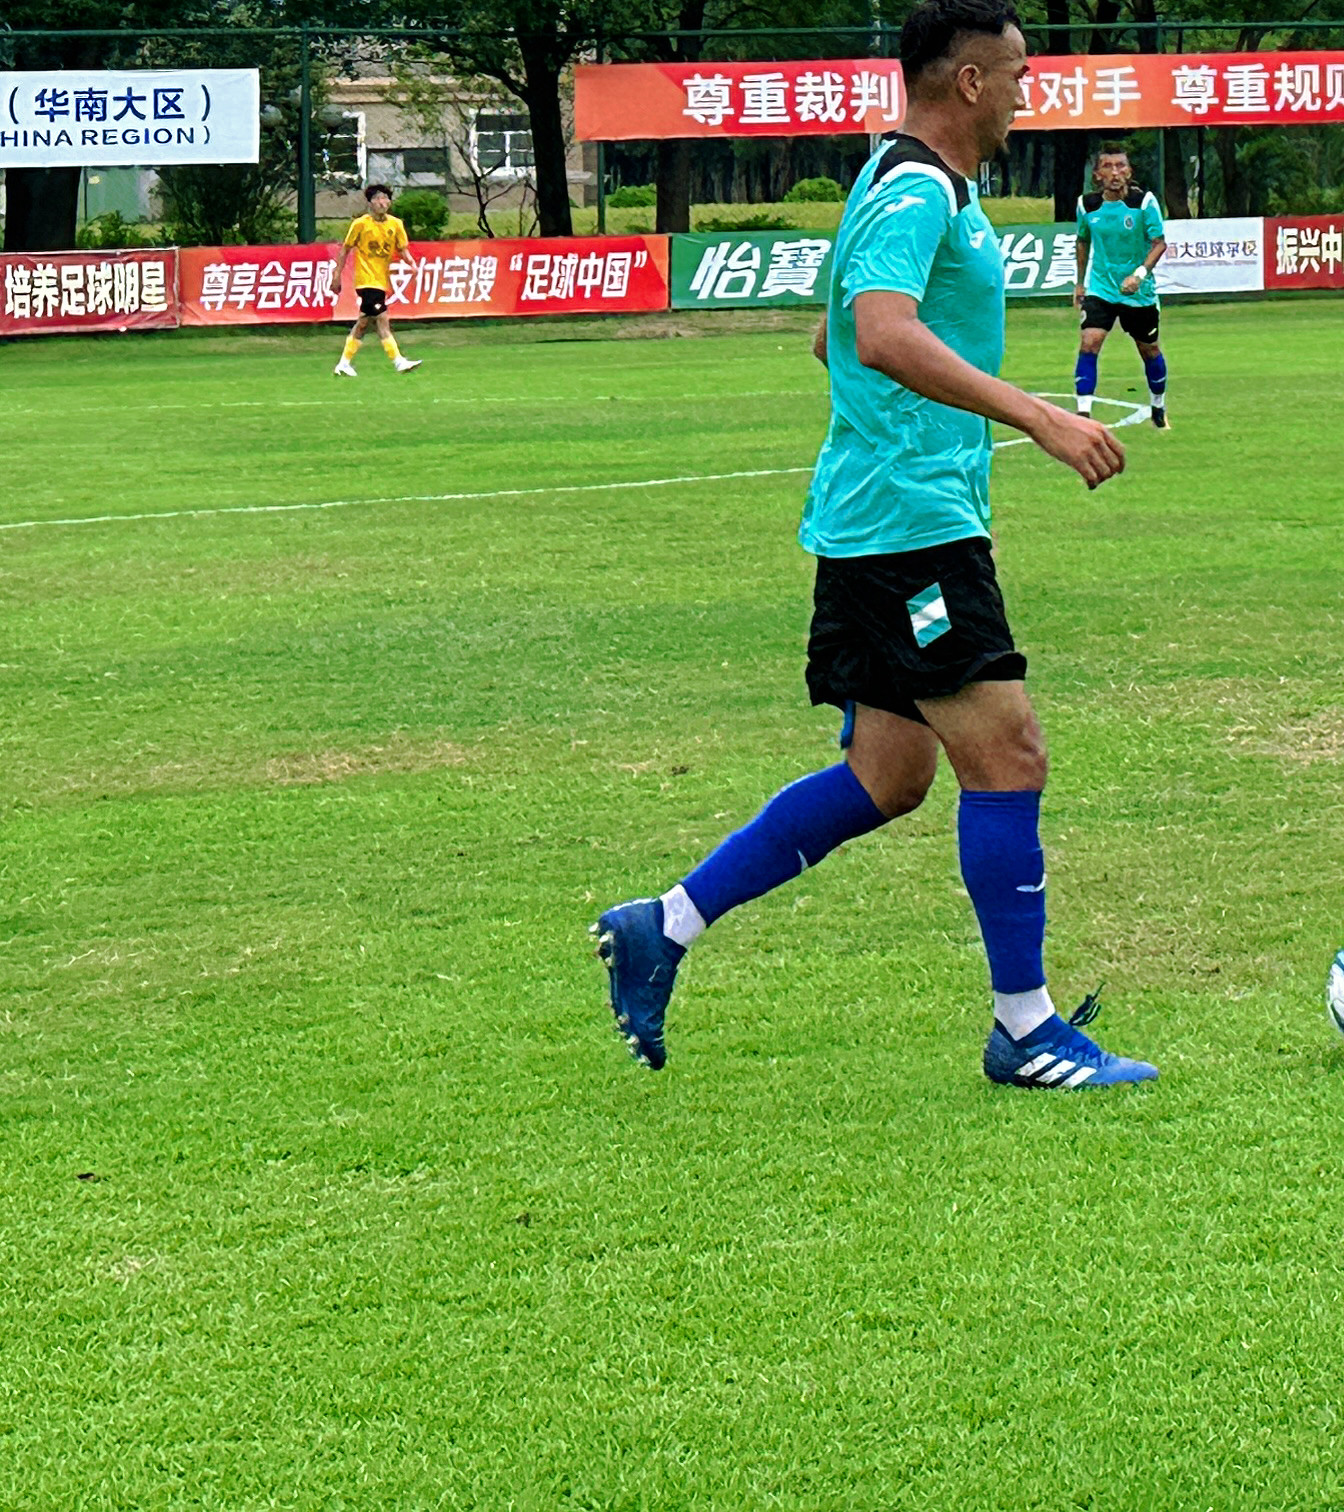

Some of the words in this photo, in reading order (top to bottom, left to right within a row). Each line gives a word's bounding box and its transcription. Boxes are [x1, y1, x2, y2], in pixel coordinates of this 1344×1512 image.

[682, 70, 899, 126] 尊重裁判
[4, 261, 168, 319] 培养足球明星
